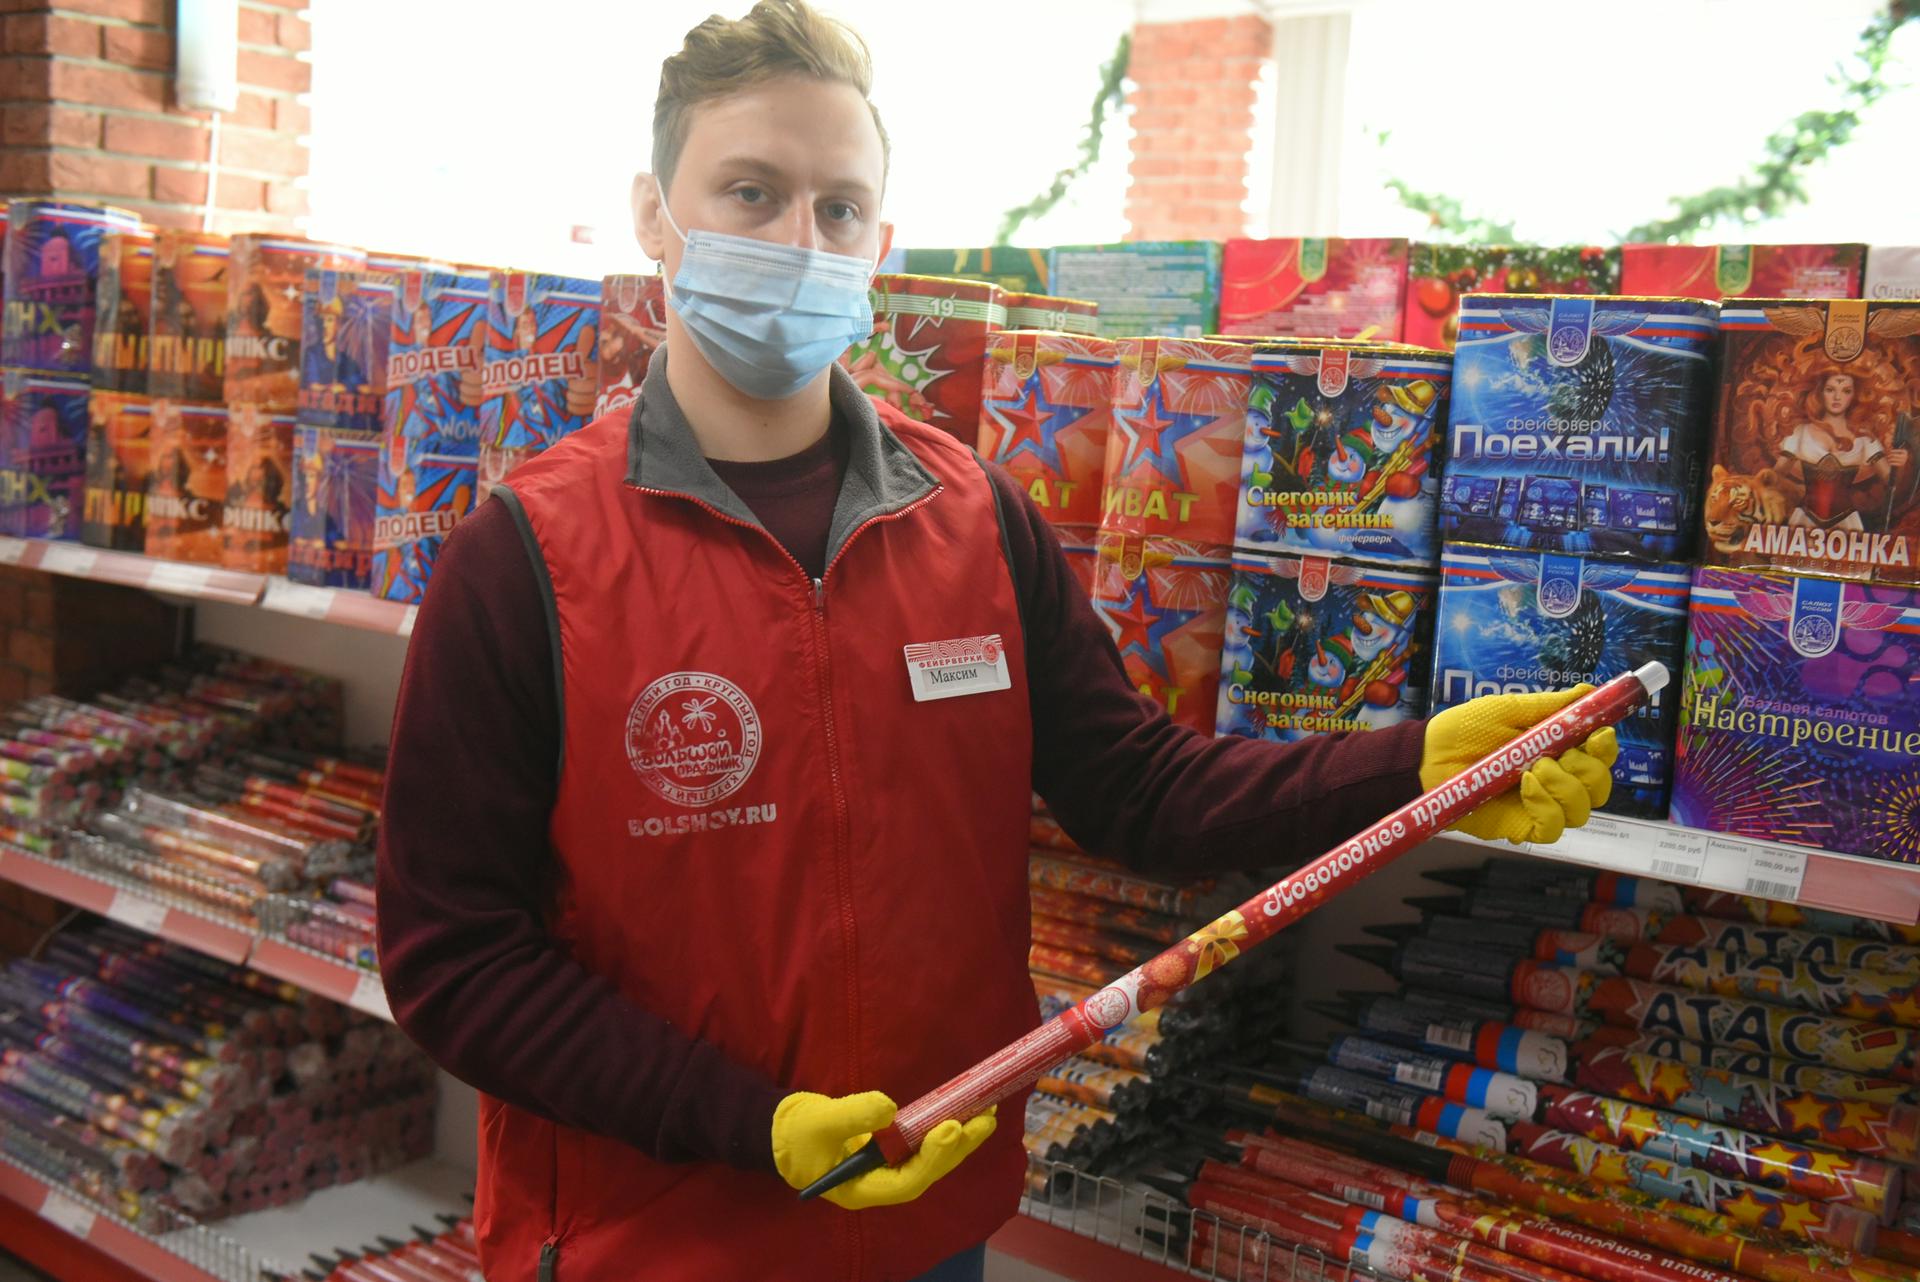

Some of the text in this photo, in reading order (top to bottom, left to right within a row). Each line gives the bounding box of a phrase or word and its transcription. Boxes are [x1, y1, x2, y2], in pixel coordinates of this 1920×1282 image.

[929, 299, 955, 318] 19
[1048, 312, 1067, 329] 19
[1506, 416, 1614, 433] фейерверк
[1452, 424, 1670, 463] Поехали!
[1247, 486, 1357, 507] Снеговик
[1286, 507, 1394, 529] затейник
[1744, 523, 1910, 567] АМАЗОНКА
[930, 668, 979, 685] Максим
[1496, 663, 1604, 685] фейерверк
[1227, 683, 1337, 710] Снеговик
[664, 677, 692, 690] ГОД
[704, 678, 755, 726] КРУГЛЫЙ
[746, 729, 757, 758] ГОД
[1266, 711, 1373, 733] затейник
[1691, 692, 1920, 756] Настроение
[1743, 695, 1889, 726] Батарея салютов
[627, 803, 778, 838] BOLSHOY.RU
[1263, 820, 1407, 917] Новогоднее
[1411, 723, 1566, 828] приключение
[1642, 992, 1823, 1063] АТАС
